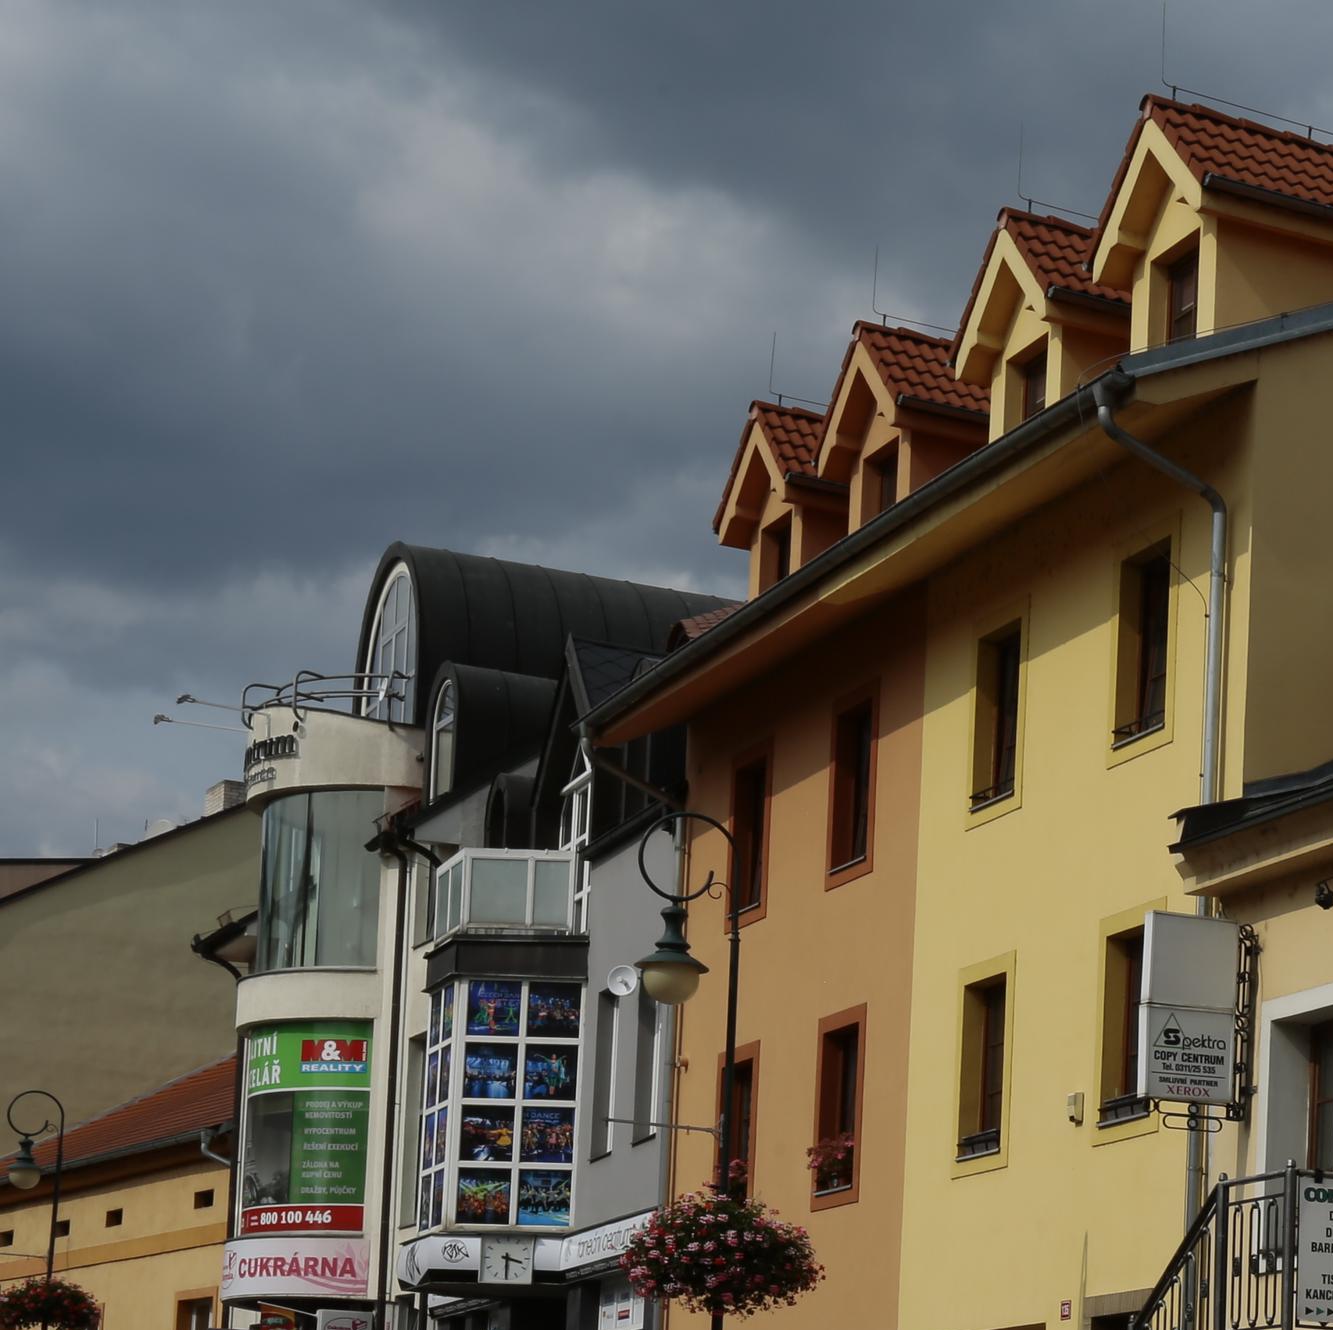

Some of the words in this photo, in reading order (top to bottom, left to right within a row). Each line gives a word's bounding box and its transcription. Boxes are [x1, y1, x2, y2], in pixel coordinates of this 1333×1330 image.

[1163, 1028, 1226, 1050] Spektra
[1154, 1050, 1178, 1061] COPY
[1181, 1052, 1224, 1065] CENTRUM
[302, 1064, 362, 1072] REALITY
[1167, 1085, 1210, 1097] XEROX
[260, 1212, 278, 1225] 800
[280, 1211, 302, 1224] 100
[305, 1210, 332, 1224] 446
[238, 1252, 357, 1279] CUKRÁRNA
